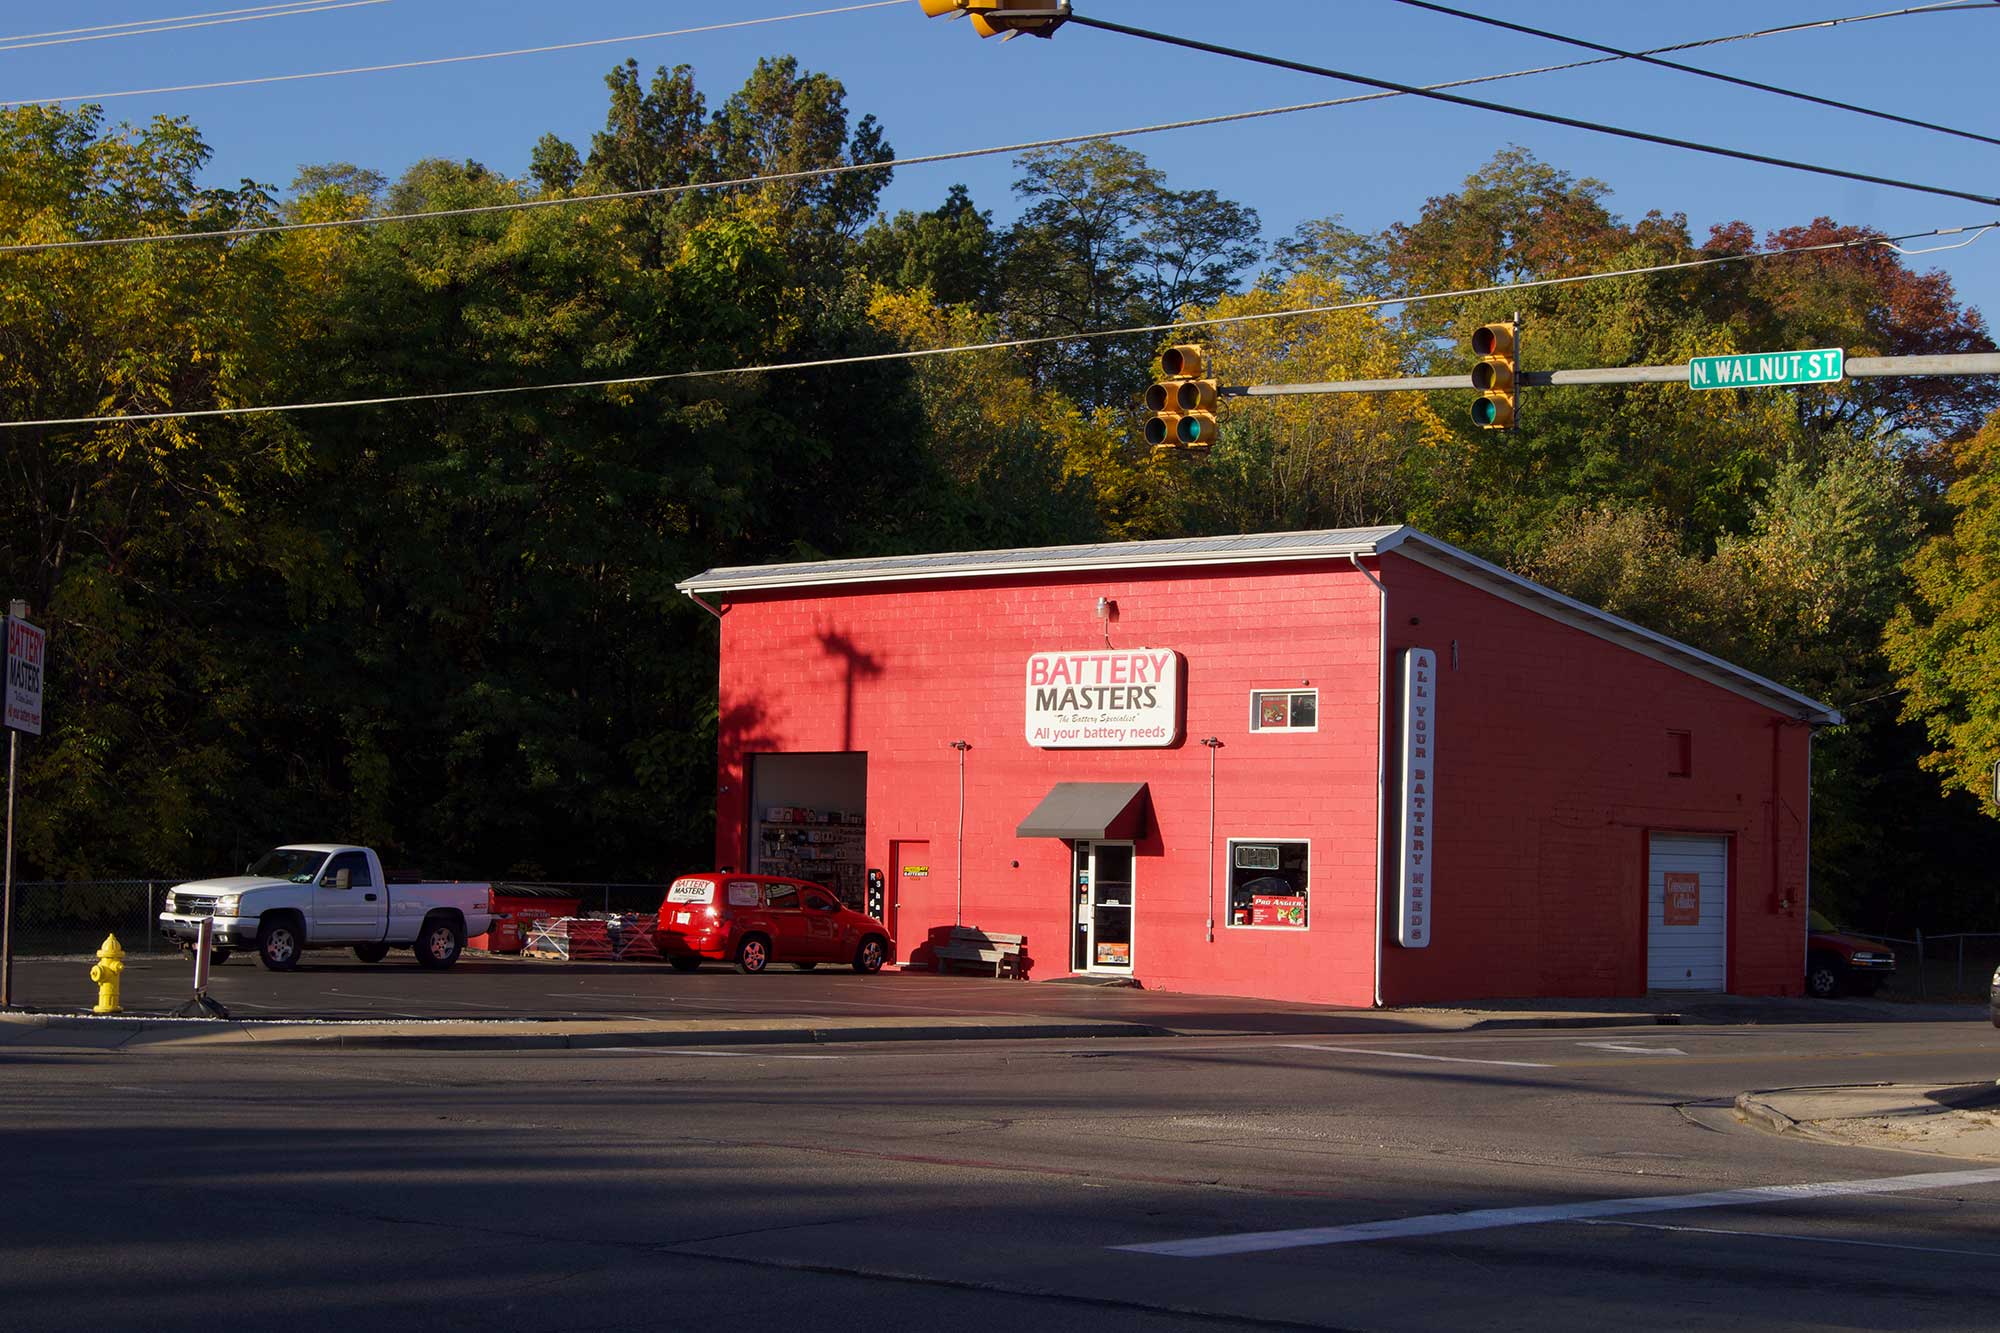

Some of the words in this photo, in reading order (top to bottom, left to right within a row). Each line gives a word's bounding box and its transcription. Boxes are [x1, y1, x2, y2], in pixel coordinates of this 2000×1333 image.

[1693, 361, 1711, 385] N.
[1715, 355, 1801, 383] WALNUT
[1808, 352, 1839, 379] ST.
[9, 620, 44, 665] BATTERY
[9, 656, 40, 694] MASTERS
[1030, 653, 1170, 686] BATTERY
[1416, 655, 1429, 698] ALL
[1035, 685, 1157, 711] MASTERS
[1034, 727, 1050, 740] All
[1053, 728, 1080, 743] your
[1084, 727, 1126, 742] battery
[1130, 726, 1166, 739] needs
[1071, 713, 1098, 724] Battery
[1415, 706, 1427, 759] YOUR
[1413, 769, 1426, 865] BATTERY
[674, 887, 705, 895] MASTERS
[675, 880, 711, 889] BATTERY
[1411, 872, 1424, 940] NEEDS
